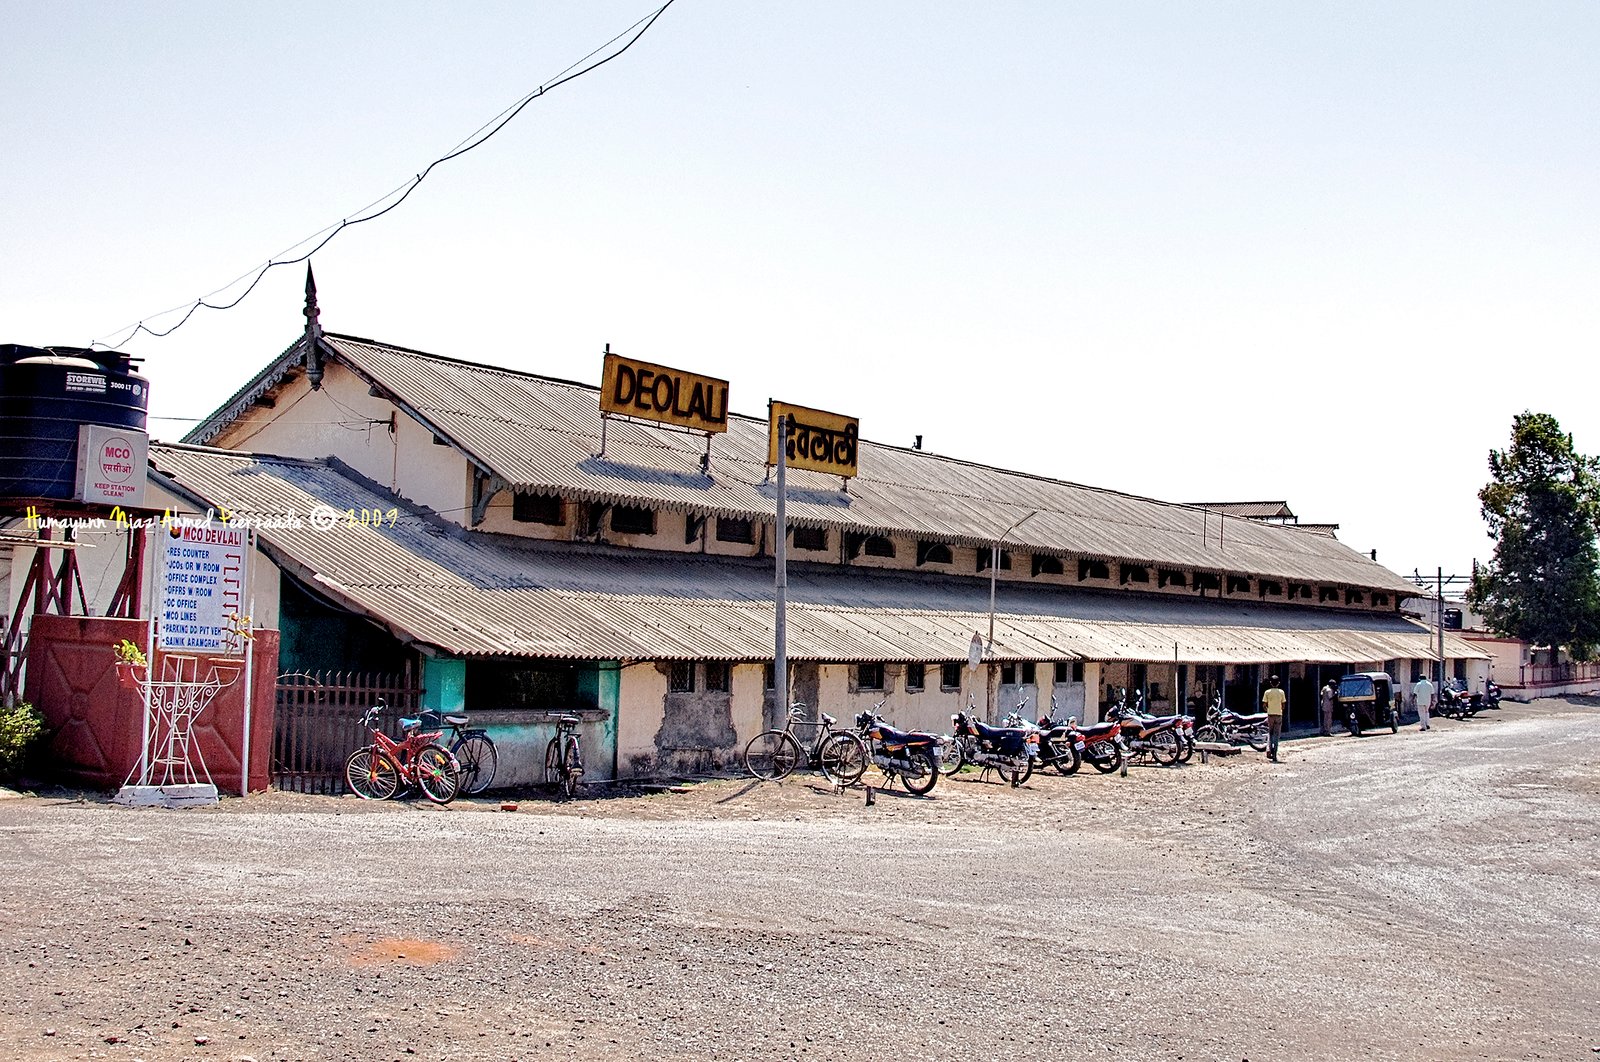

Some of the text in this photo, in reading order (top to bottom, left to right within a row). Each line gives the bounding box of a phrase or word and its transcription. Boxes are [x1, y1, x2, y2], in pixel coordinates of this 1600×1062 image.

[614, 364, 726, 424] DEOLALI
[105, 446, 130, 459] MCO
[103, 462, 132, 474] एमसीओ
[94, 482, 136, 492] KEEP STATION
[183, 526, 242, 546] MCO DEVLALI
[182, 548, 210, 559] COUNTER
[186, 562, 193, 570] OR
[203, 563, 219, 572] ROOM
[168, 573, 217, 584] OFFICE COMPLEX
[177, 600, 196, 608] OFFICE
[181, 613, 196, 621] LINES
[166, 624, 187, 633] PARKING
